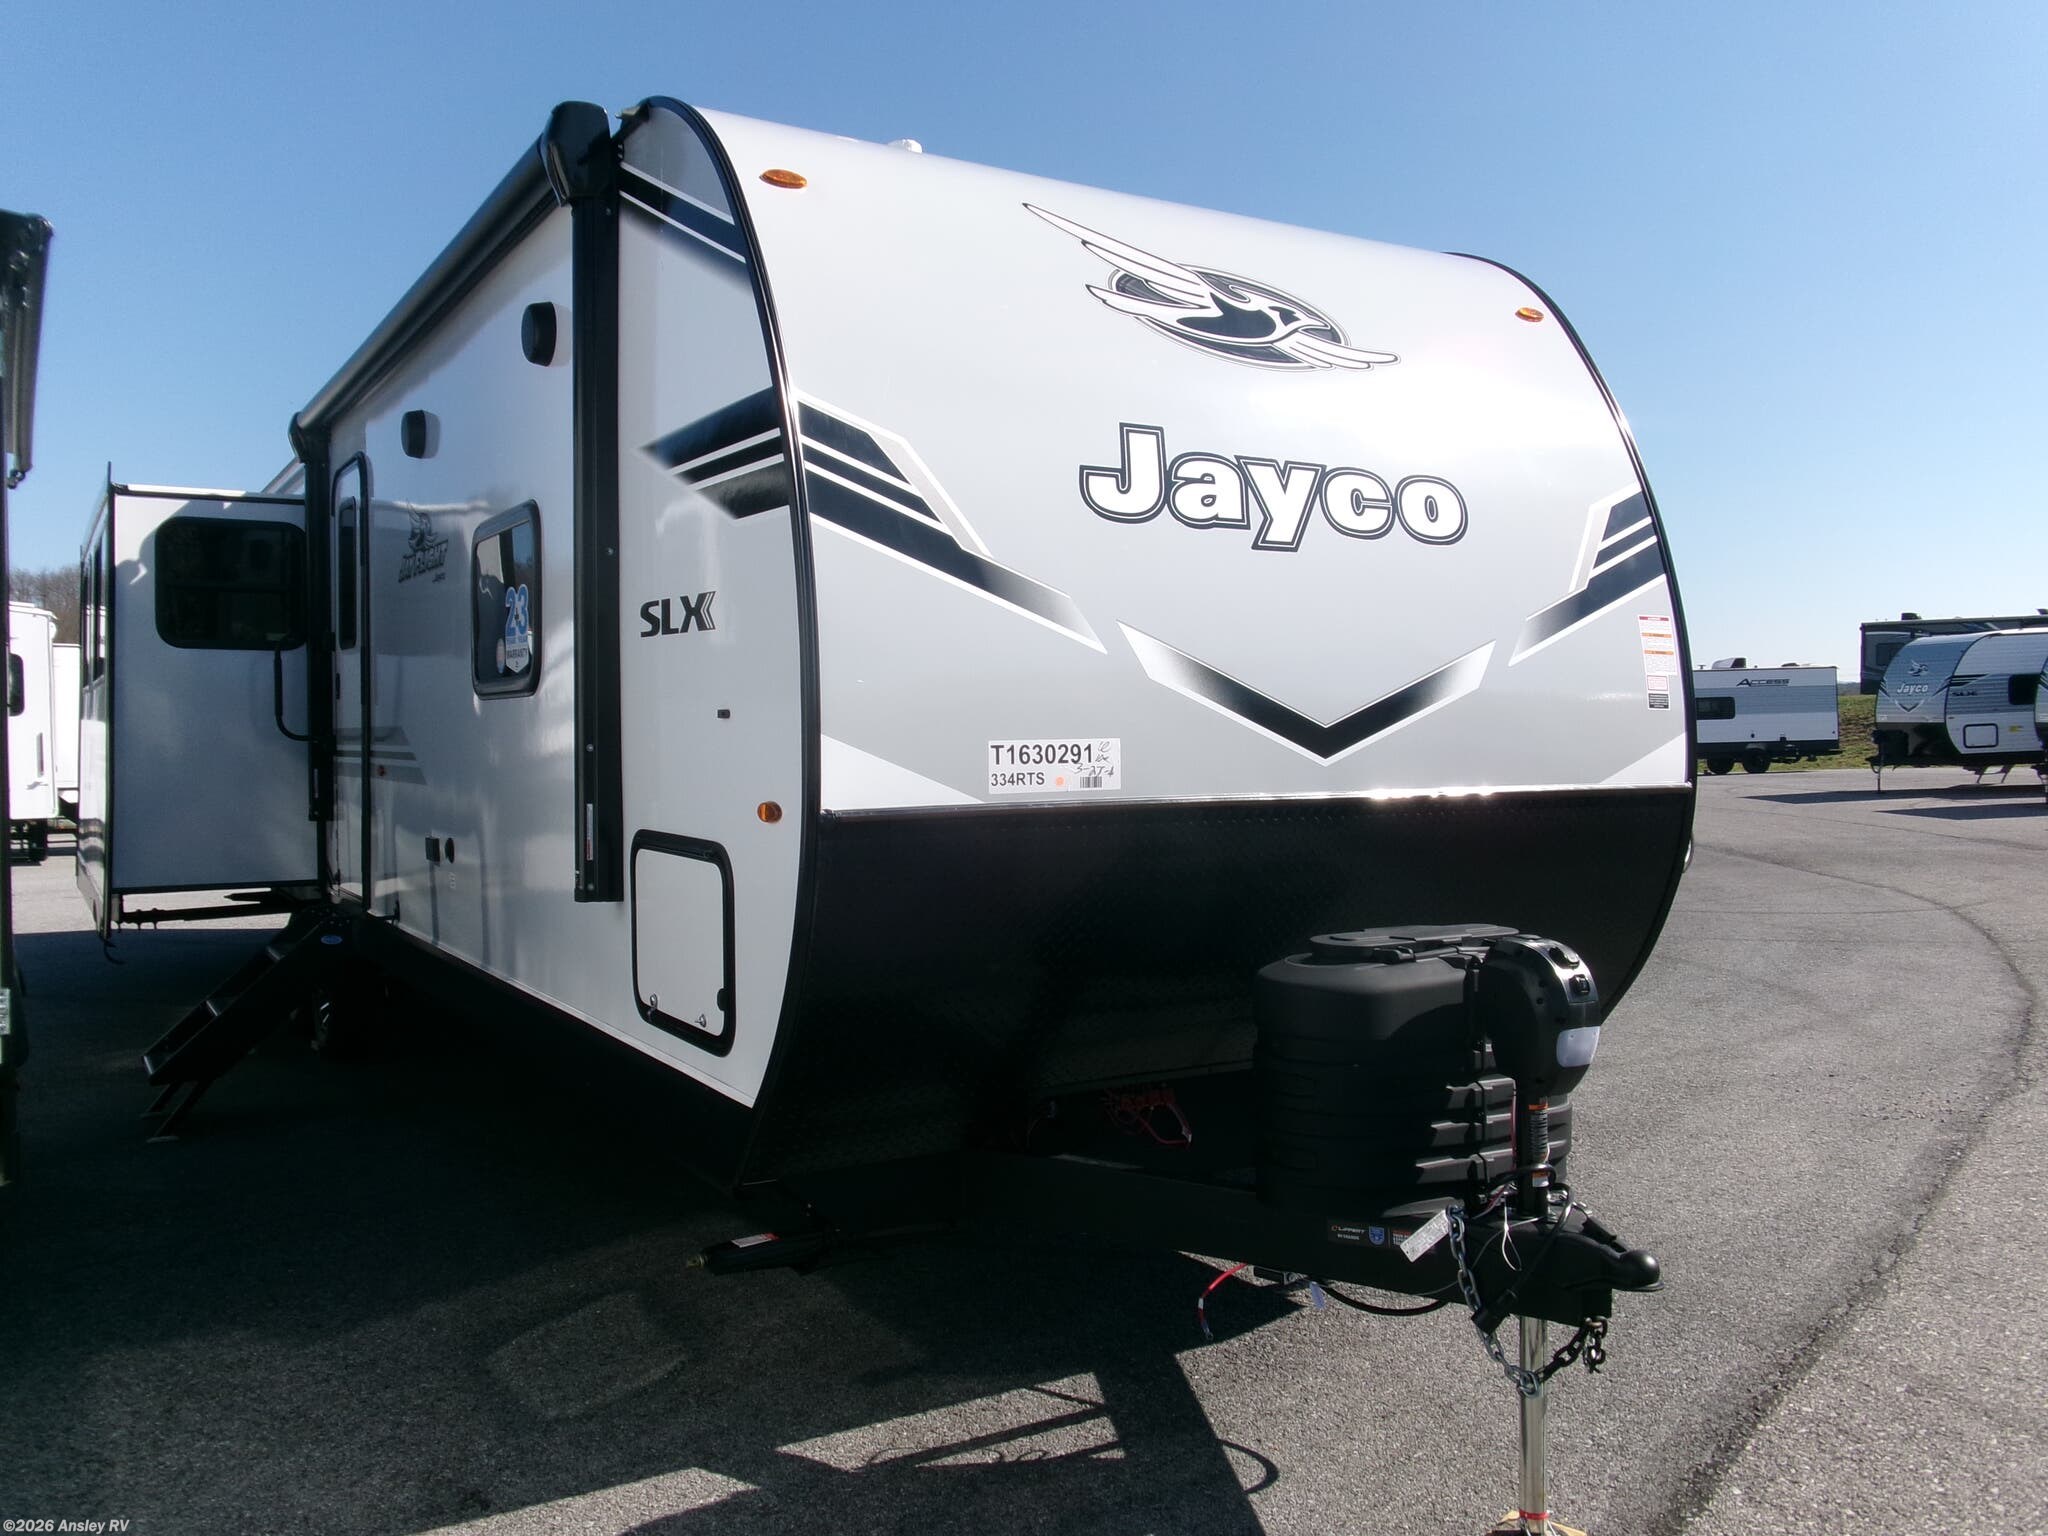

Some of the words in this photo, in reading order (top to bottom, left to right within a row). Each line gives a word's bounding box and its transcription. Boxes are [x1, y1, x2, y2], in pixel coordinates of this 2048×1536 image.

[1079, 422, 1469, 552] Jayco
[640, 591, 716, 638] SLX
[1896, 682, 1929, 694] Jayco
[990, 743, 1092, 765] T1630291
[990, 771, 1045, 787] 334RTS
